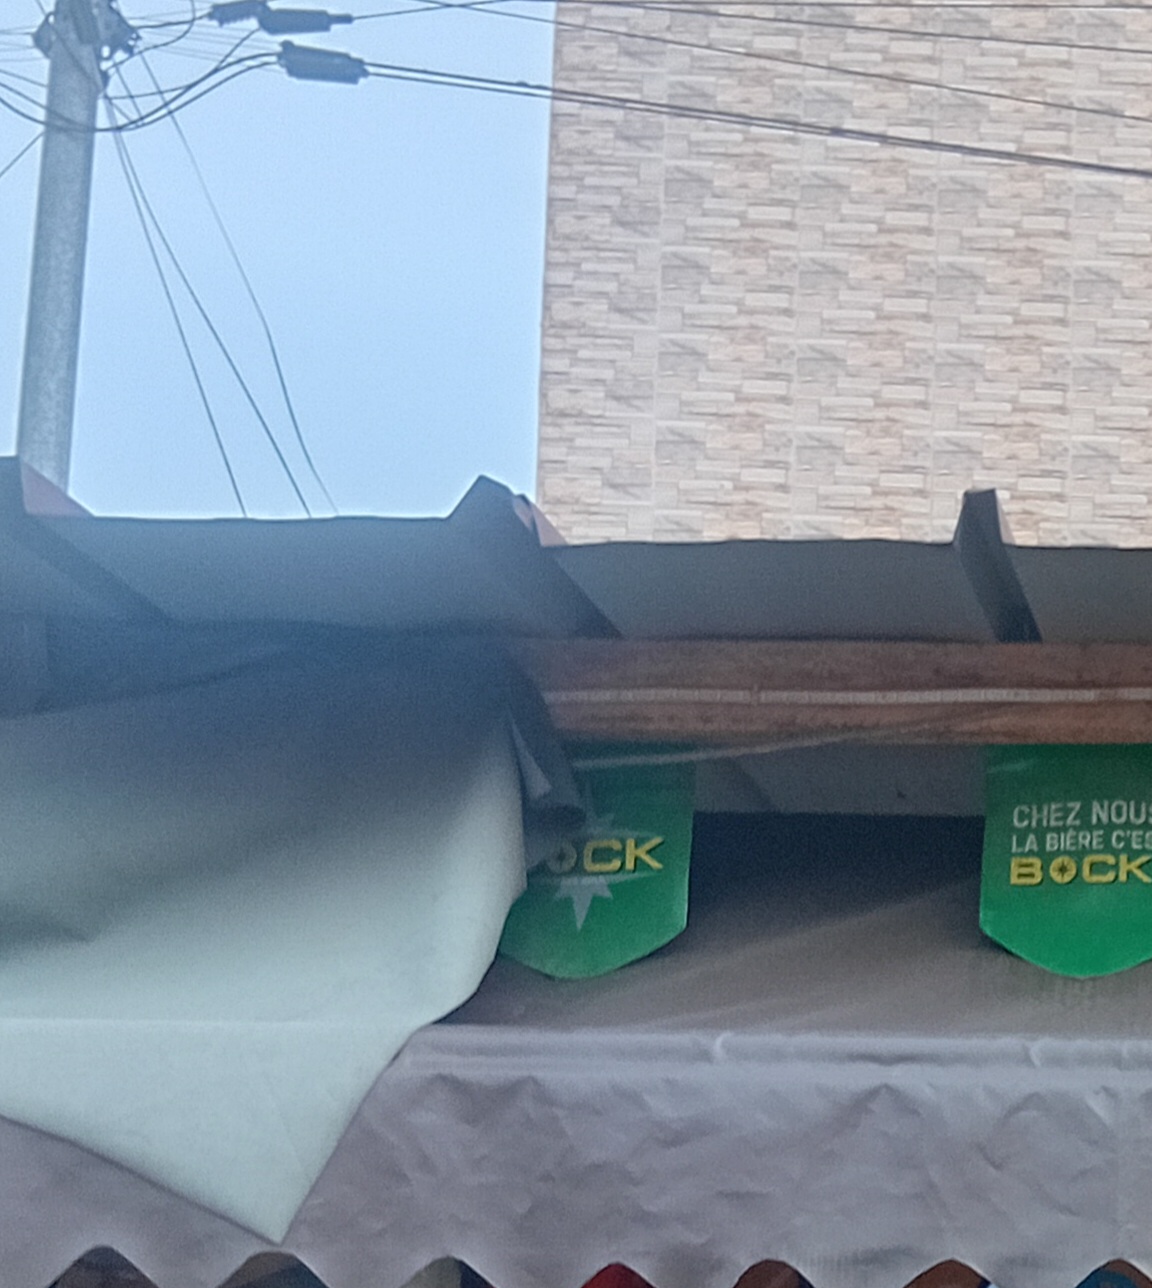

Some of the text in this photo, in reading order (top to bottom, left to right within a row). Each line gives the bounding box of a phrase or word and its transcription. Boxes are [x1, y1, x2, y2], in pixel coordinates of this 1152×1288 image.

[1012, 801, 1082, 829] CHEZ
[1011, 832, 1040, 853] LA
[1046, 827, 1105, 852] BIÈRE
[546, 836, 664, 874] OCK
